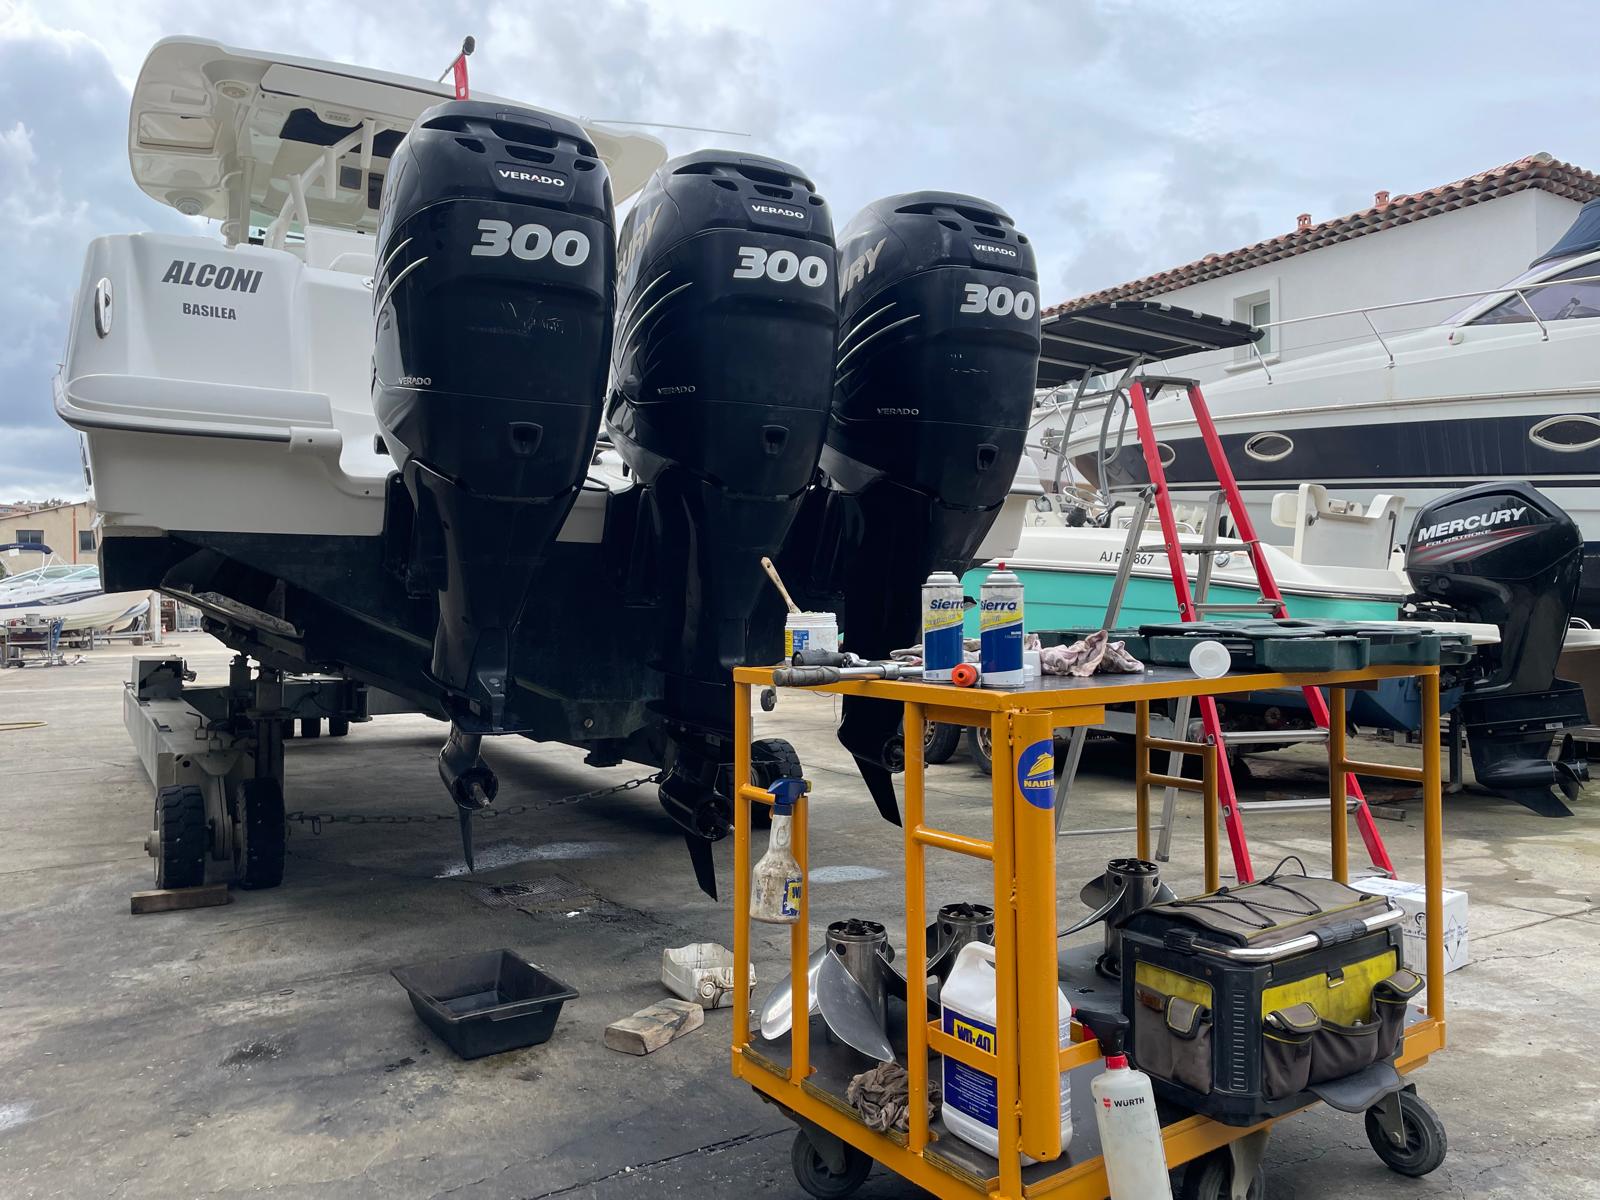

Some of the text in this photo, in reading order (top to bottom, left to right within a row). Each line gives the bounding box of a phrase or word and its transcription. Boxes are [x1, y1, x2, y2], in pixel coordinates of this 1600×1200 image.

[498, 169, 565, 187] VERADO
[751, 204, 805, 220] VERADO
[471, 219, 590, 267] 300
[974, 243, 1017, 257] VERADO
[733, 246, 828, 288] 300
[161, 260, 263, 294] ALCONI
[182, 302, 237, 320] BASILEA
[960, 283, 1036, 321] 300
[398, 376, 432, 386] VERADO
[876, 407, 920, 416] VERADO
[1417, 506, 1527, 543] MERCURY
[1425, 529, 1492, 548] FOURSTROKE
[1099, 551, 1113, 562] AJ
[956, 1024, 991, 1053] WD-40
[1113, 1096, 1145, 1108] WÜRTH
